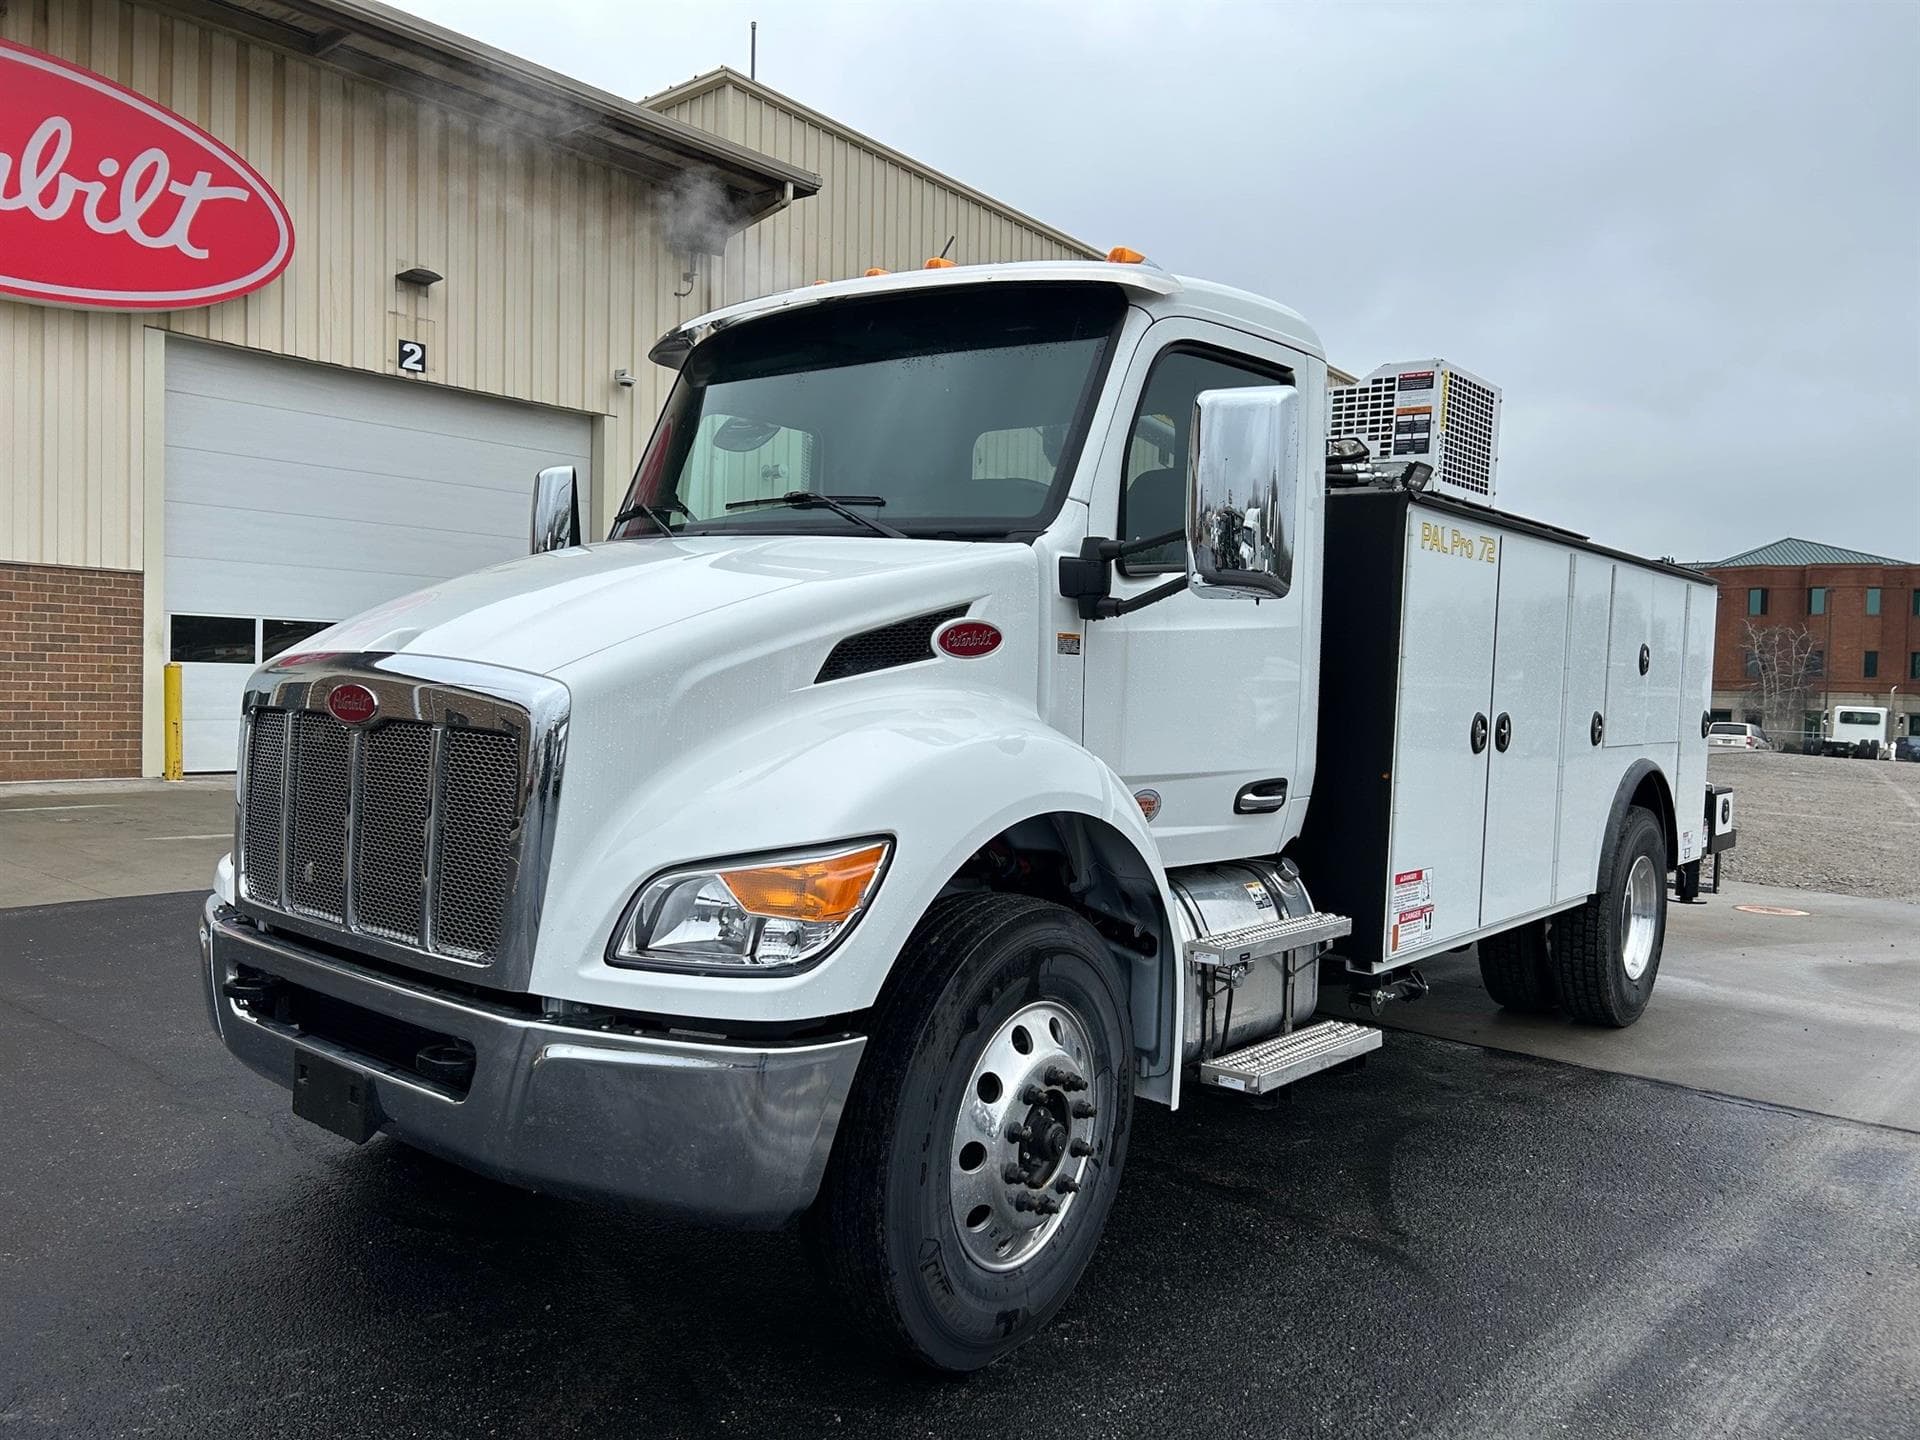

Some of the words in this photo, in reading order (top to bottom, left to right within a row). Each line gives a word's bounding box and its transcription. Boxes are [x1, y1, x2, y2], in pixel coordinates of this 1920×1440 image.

[402, 342, 423, 371] 2
[1479, 535, 1496, 563] 72
[947, 629, 997, 649] Peterbilt
